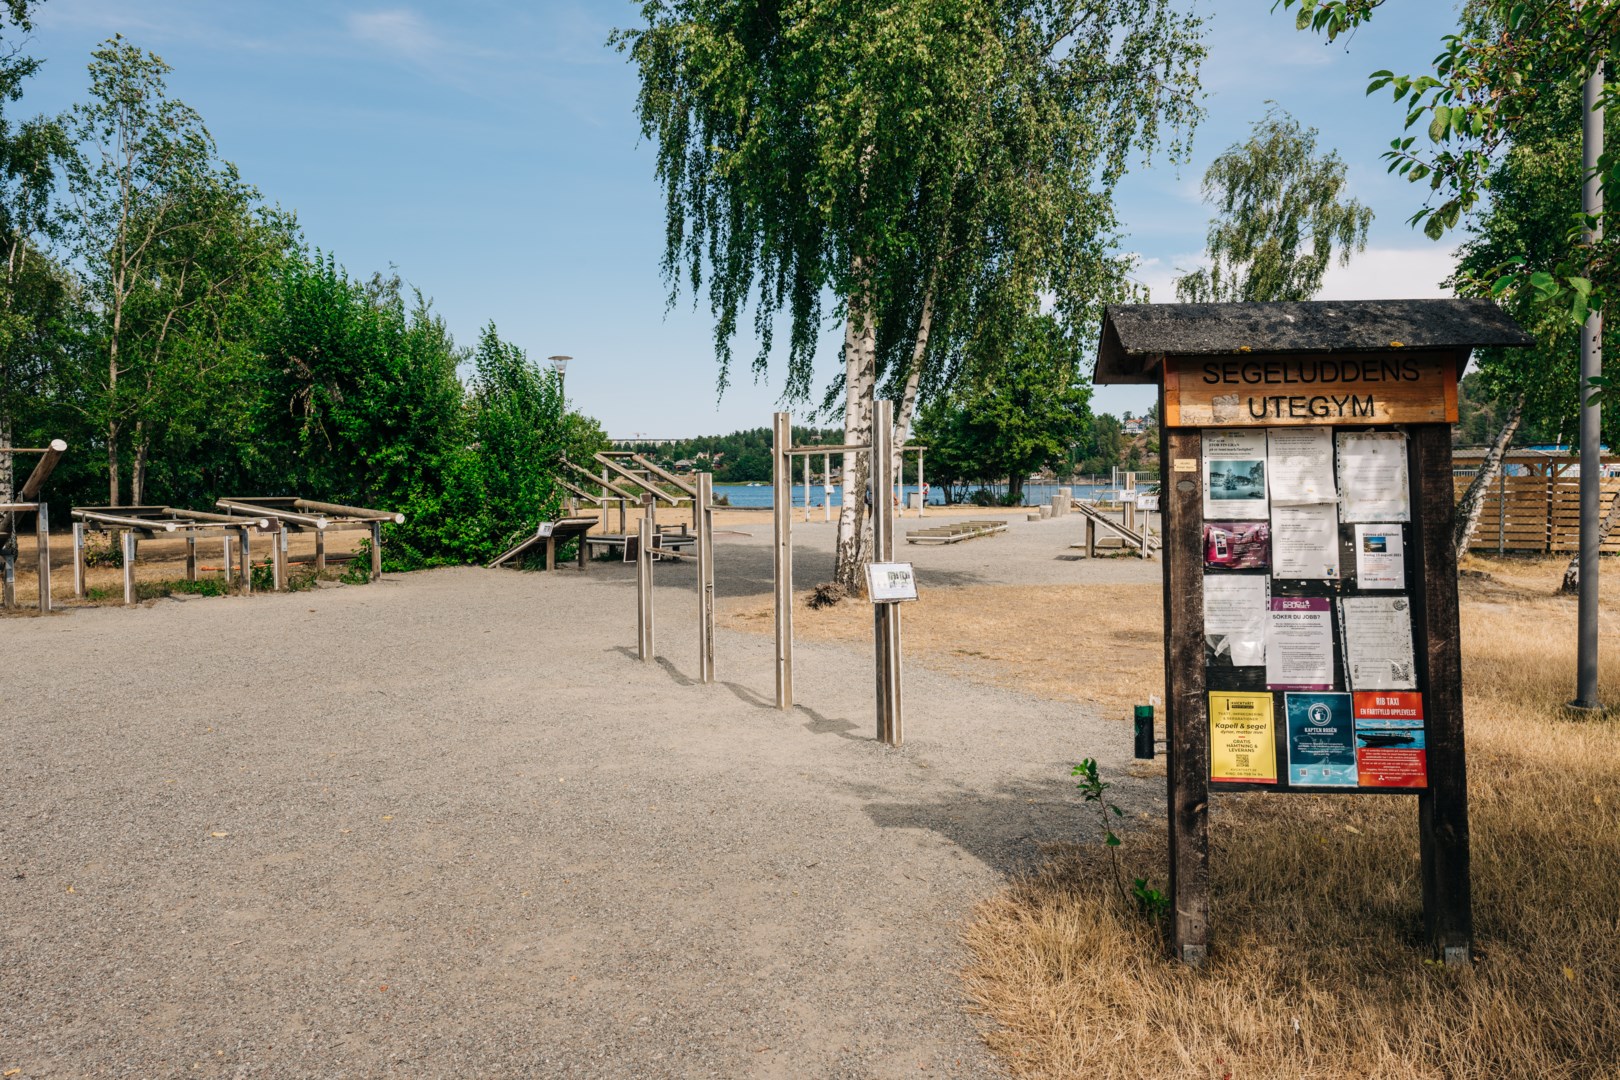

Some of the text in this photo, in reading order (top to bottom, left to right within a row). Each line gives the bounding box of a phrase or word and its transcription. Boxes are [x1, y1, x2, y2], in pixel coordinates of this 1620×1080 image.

[1202, 358, 1420, 384] SEGELUDDENS
[1249, 393, 1375, 419] UTEGYM
[1387, 698, 1400, 706] TAXI
